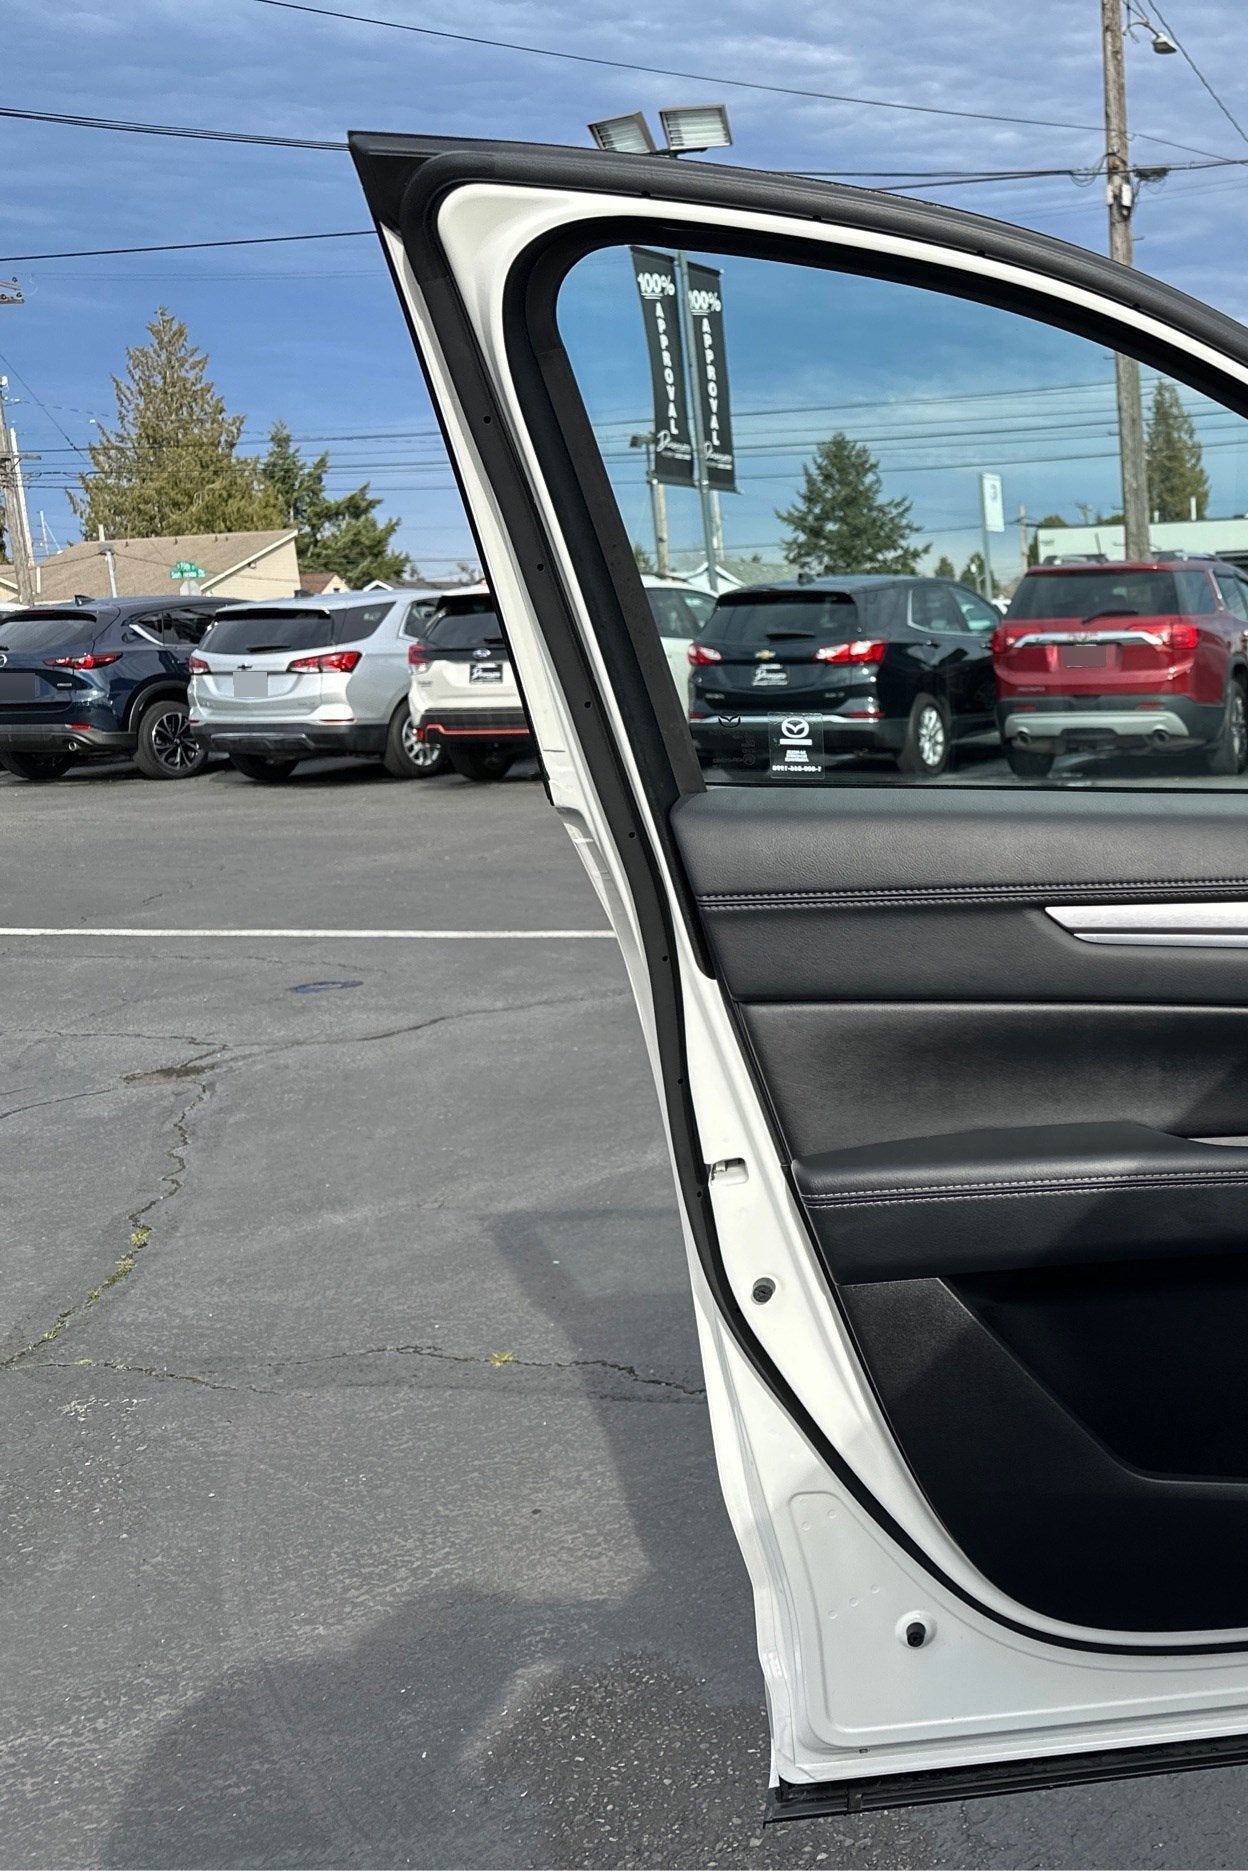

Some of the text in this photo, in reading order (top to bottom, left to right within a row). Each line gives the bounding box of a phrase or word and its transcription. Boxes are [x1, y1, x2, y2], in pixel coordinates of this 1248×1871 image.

[637, 272, 676, 296] 100%
[688, 289, 722, 312] 100%
[655, 302, 679, 435] APPROVAL
[702, 318, 720, 446] APPROVAL
